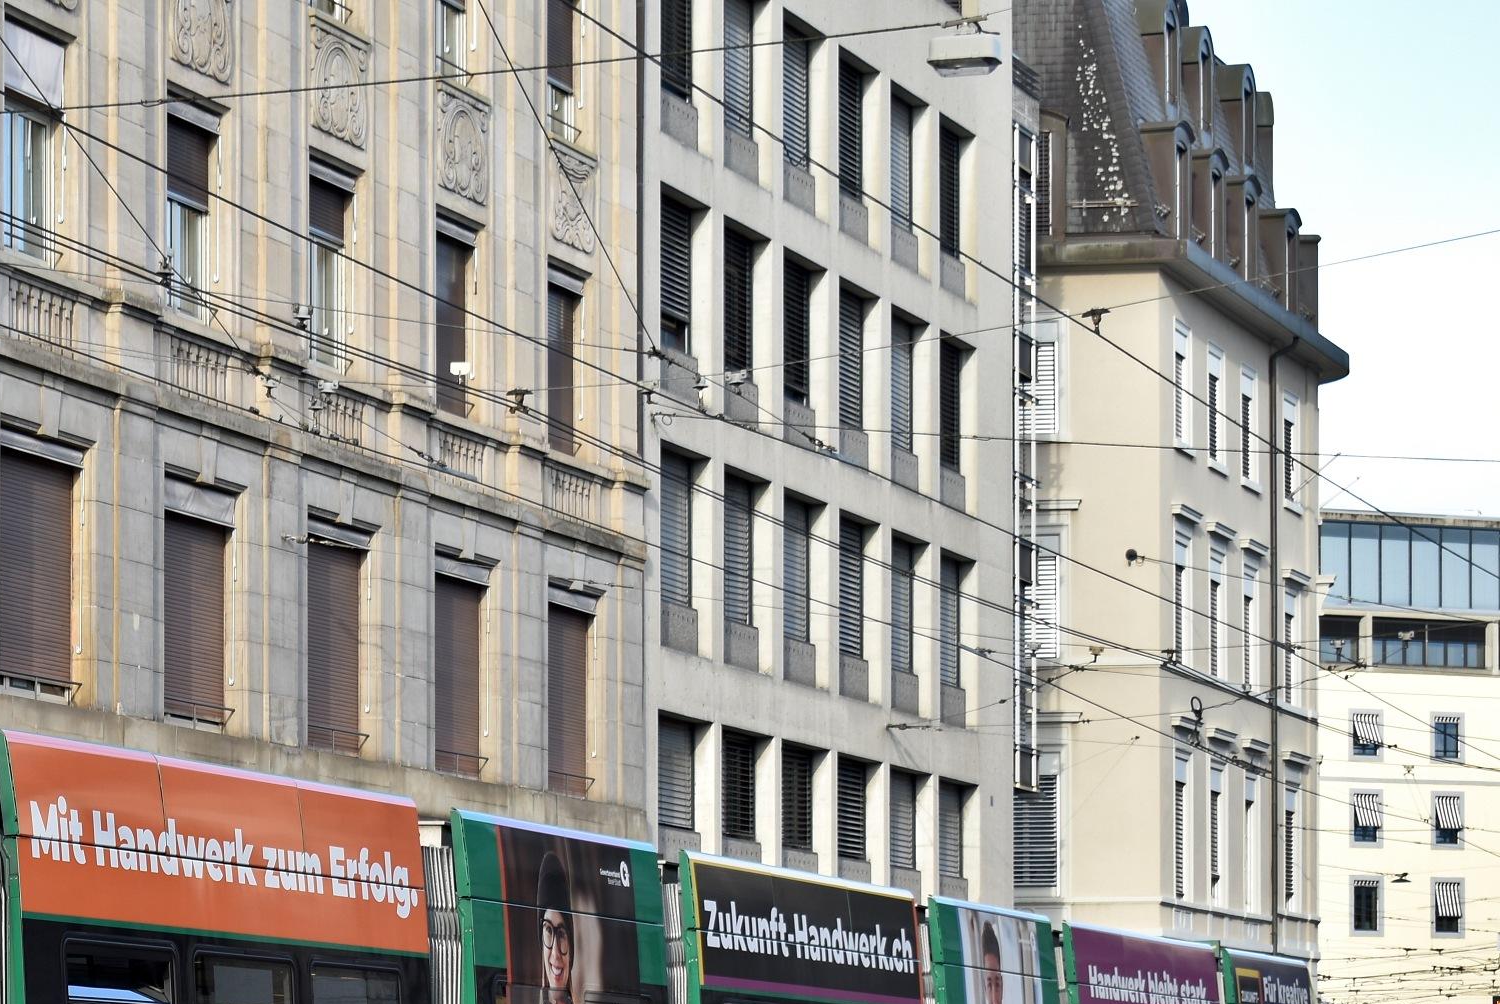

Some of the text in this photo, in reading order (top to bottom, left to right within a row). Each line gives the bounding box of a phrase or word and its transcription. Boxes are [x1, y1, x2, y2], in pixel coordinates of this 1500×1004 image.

[29, 795, 420, 919] Mit Handwerk zum Erfolg.
[703, 899, 915, 975] Zukunft-Handwerk.ch
[1088, 963, 1148, 1004] Handwerk
[1262, 975, 1276, 1004] Für
